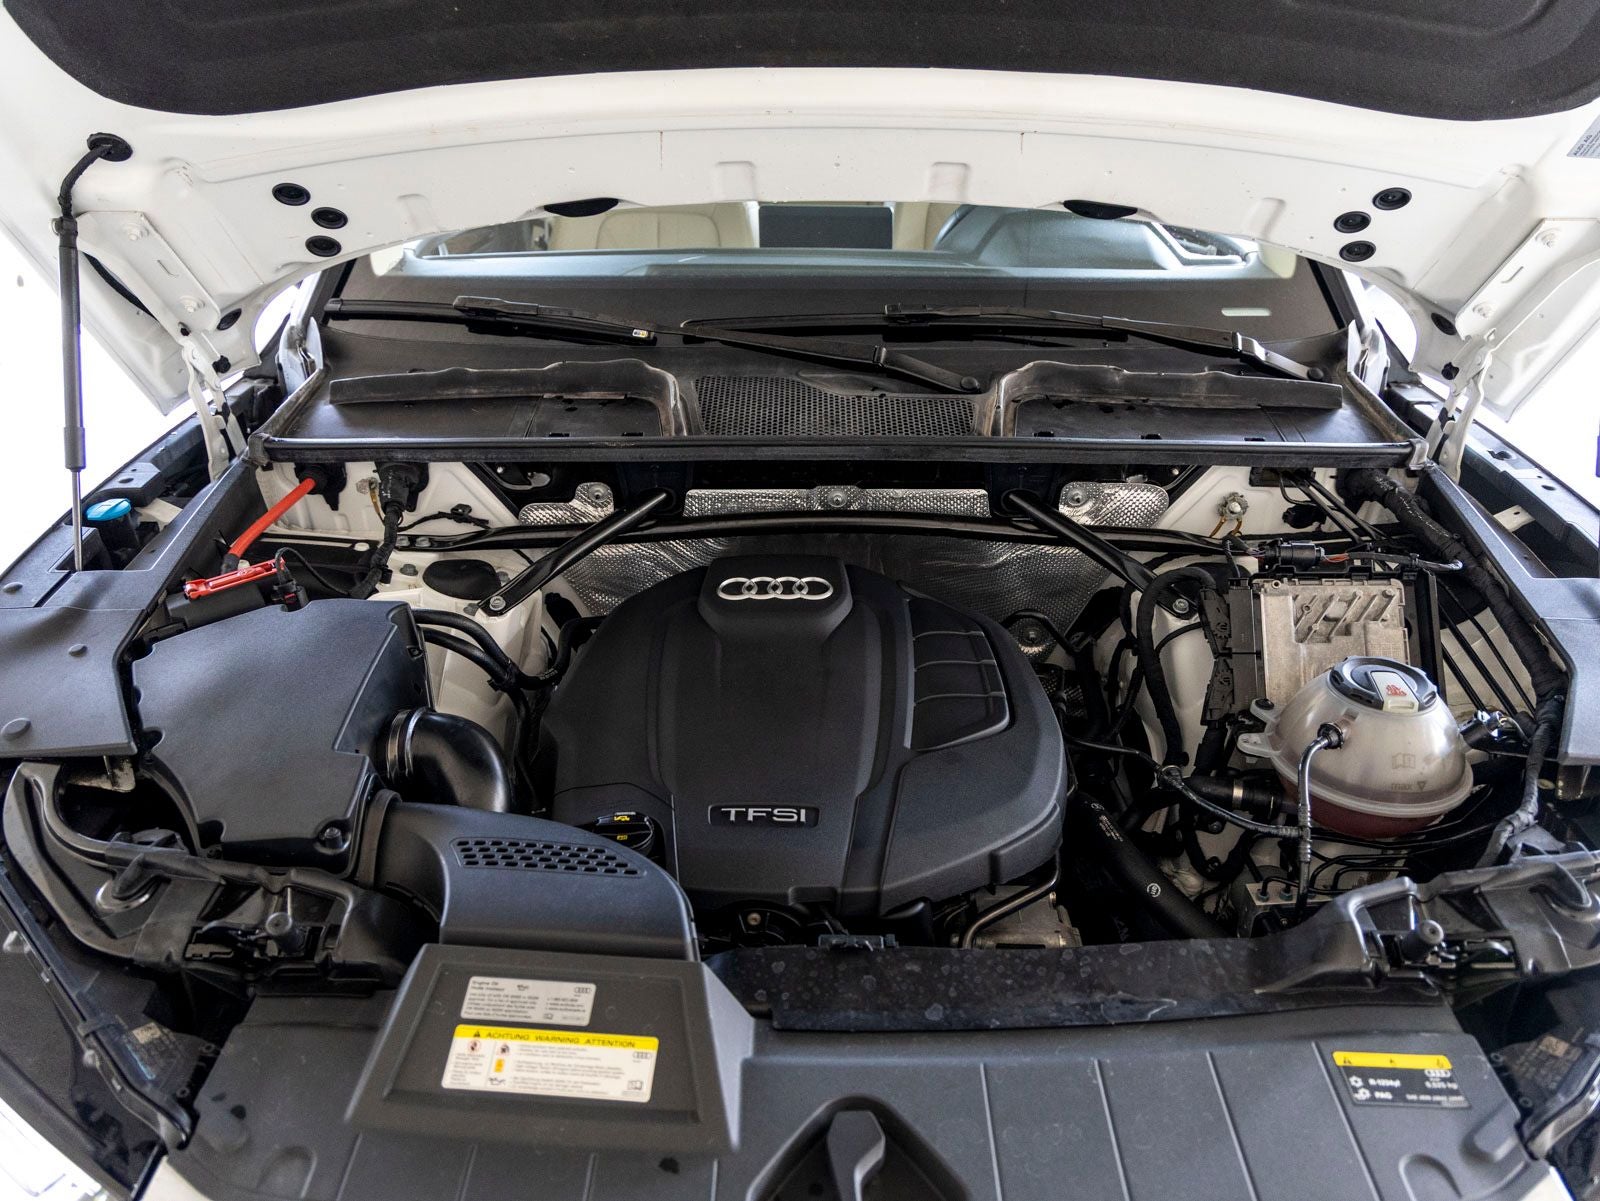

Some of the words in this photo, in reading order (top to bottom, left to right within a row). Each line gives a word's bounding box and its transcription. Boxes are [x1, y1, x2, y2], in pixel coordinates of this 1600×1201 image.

[721, 808, 806, 822] TFSI
[486, 1032, 530, 1041] ACHTUNG
[535, 1035, 580, 1044] WARNING
[585, 1038, 636, 1048] ATTENTION
